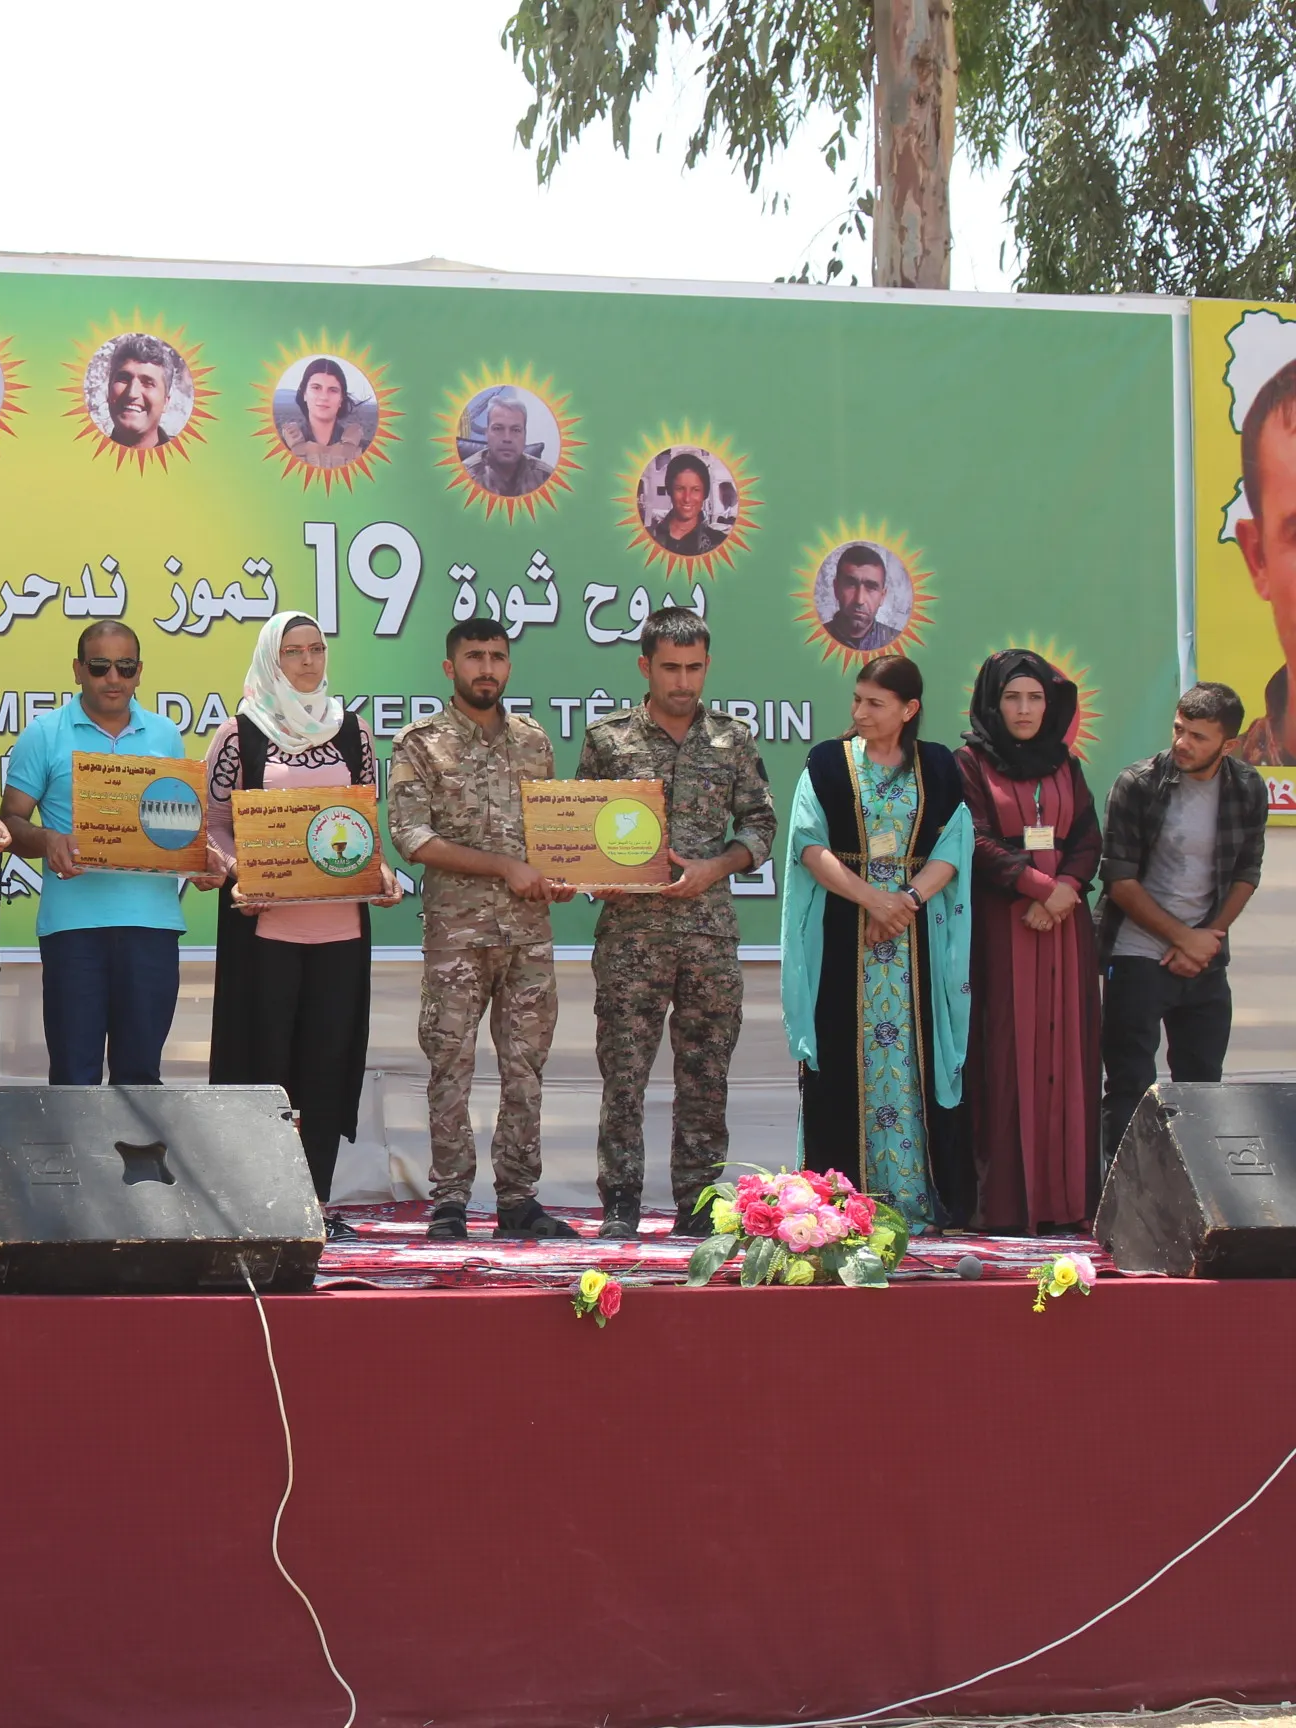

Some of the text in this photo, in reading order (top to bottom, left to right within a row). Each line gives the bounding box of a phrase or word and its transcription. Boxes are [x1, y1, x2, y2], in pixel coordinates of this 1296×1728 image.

[153, 555, 278, 634] تموز
[303, 521, 423, 635] 19
[447, 549, 560, 640] ثورة
[582, 582, 706, 643] بوح
